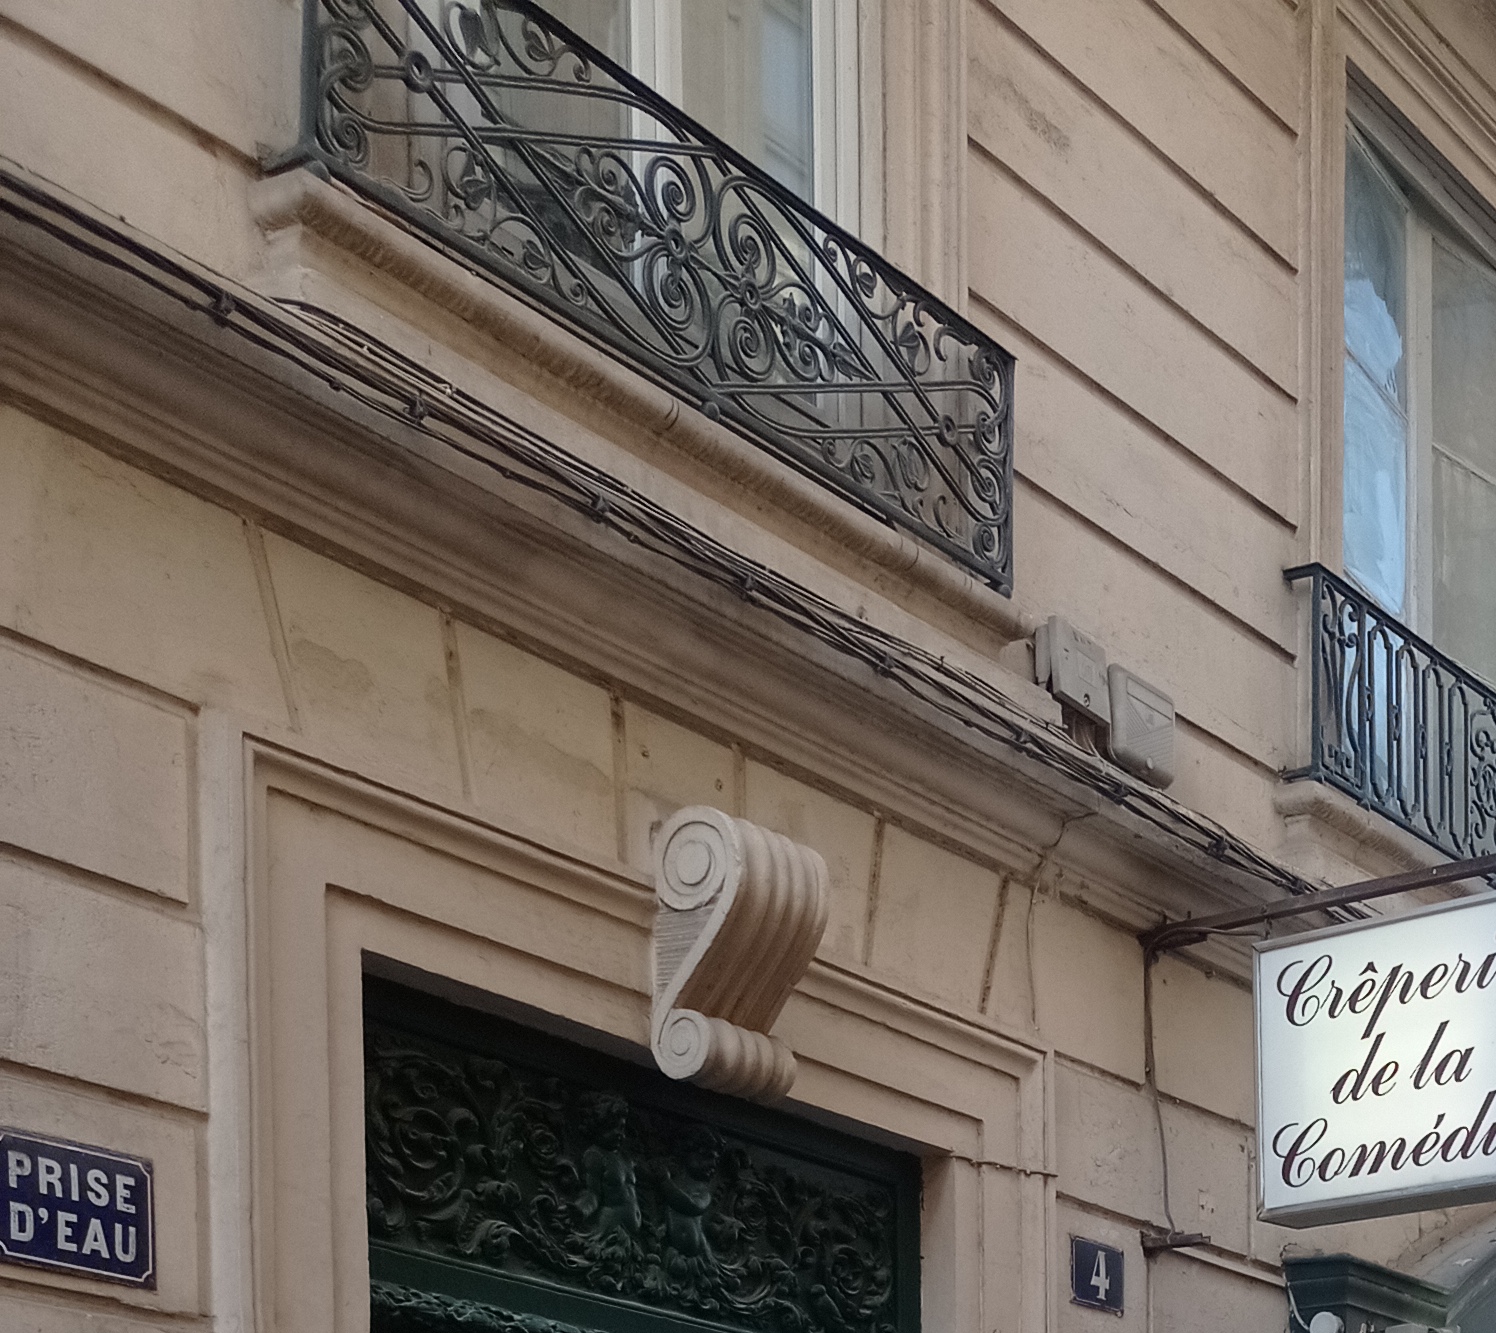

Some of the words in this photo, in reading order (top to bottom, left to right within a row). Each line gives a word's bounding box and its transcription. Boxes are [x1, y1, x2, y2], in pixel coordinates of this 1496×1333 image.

[1330, 1031, 1399, 1105] de
[1410, 1020, 1475, 1091] la
[7, 1150, 136, 1214] PRISE
[9, 1200, 137, 1263] D'EAU
[1090, 1250, 1110, 1300] 4
